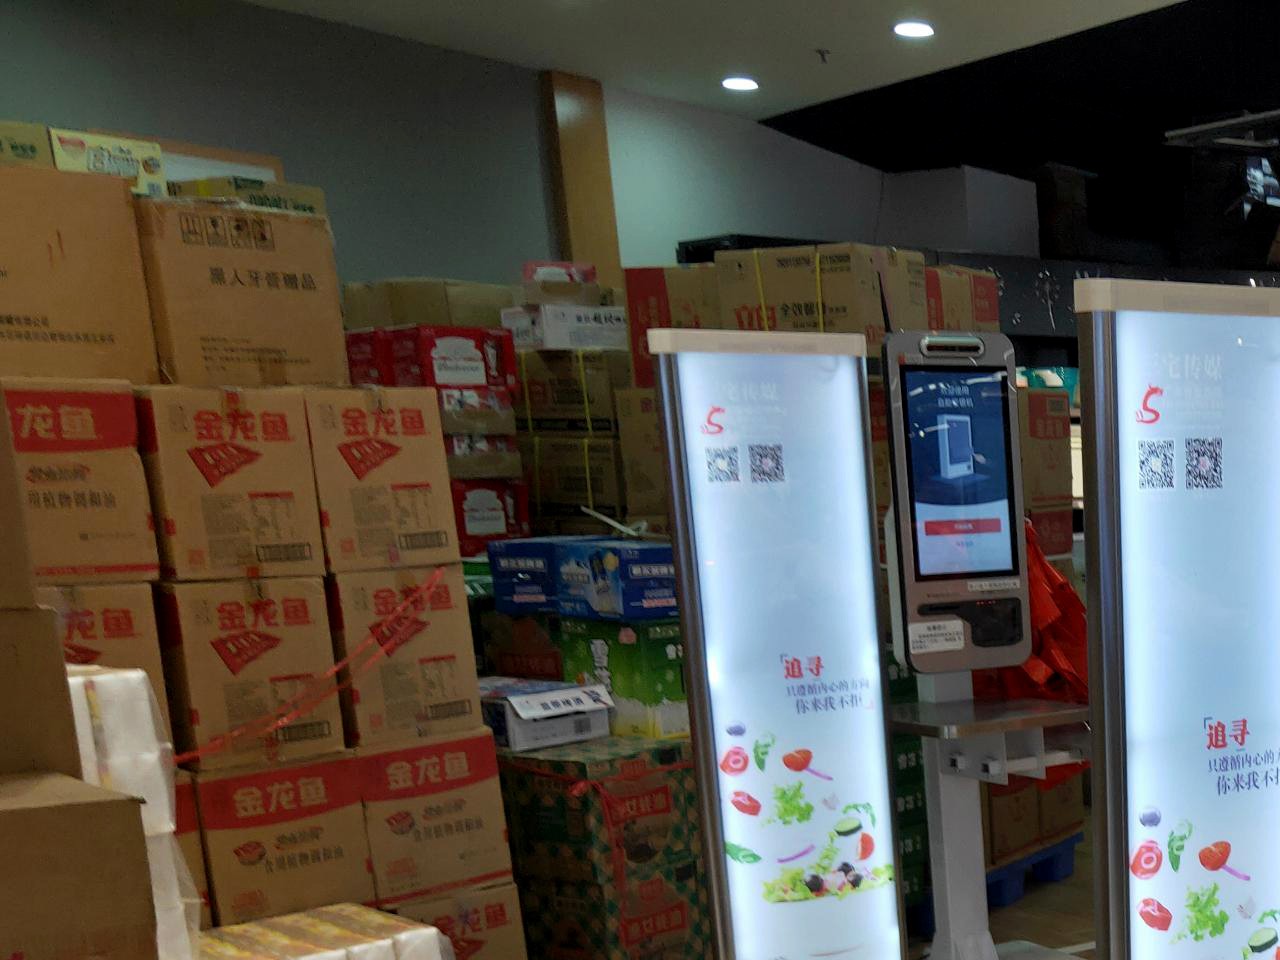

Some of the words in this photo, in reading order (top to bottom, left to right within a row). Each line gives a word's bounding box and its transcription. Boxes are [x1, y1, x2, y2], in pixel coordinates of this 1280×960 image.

[15, 403, 99, 441] 龙鱼
[192, 408, 292, 442] 金龙鱼
[341, 406, 427, 437] 金龙鱼
[216, 596, 312, 632] 金龙鱼
[386, 751, 472, 790] 金龙鱼
[232, 776, 329, 819] 金龙鱼
